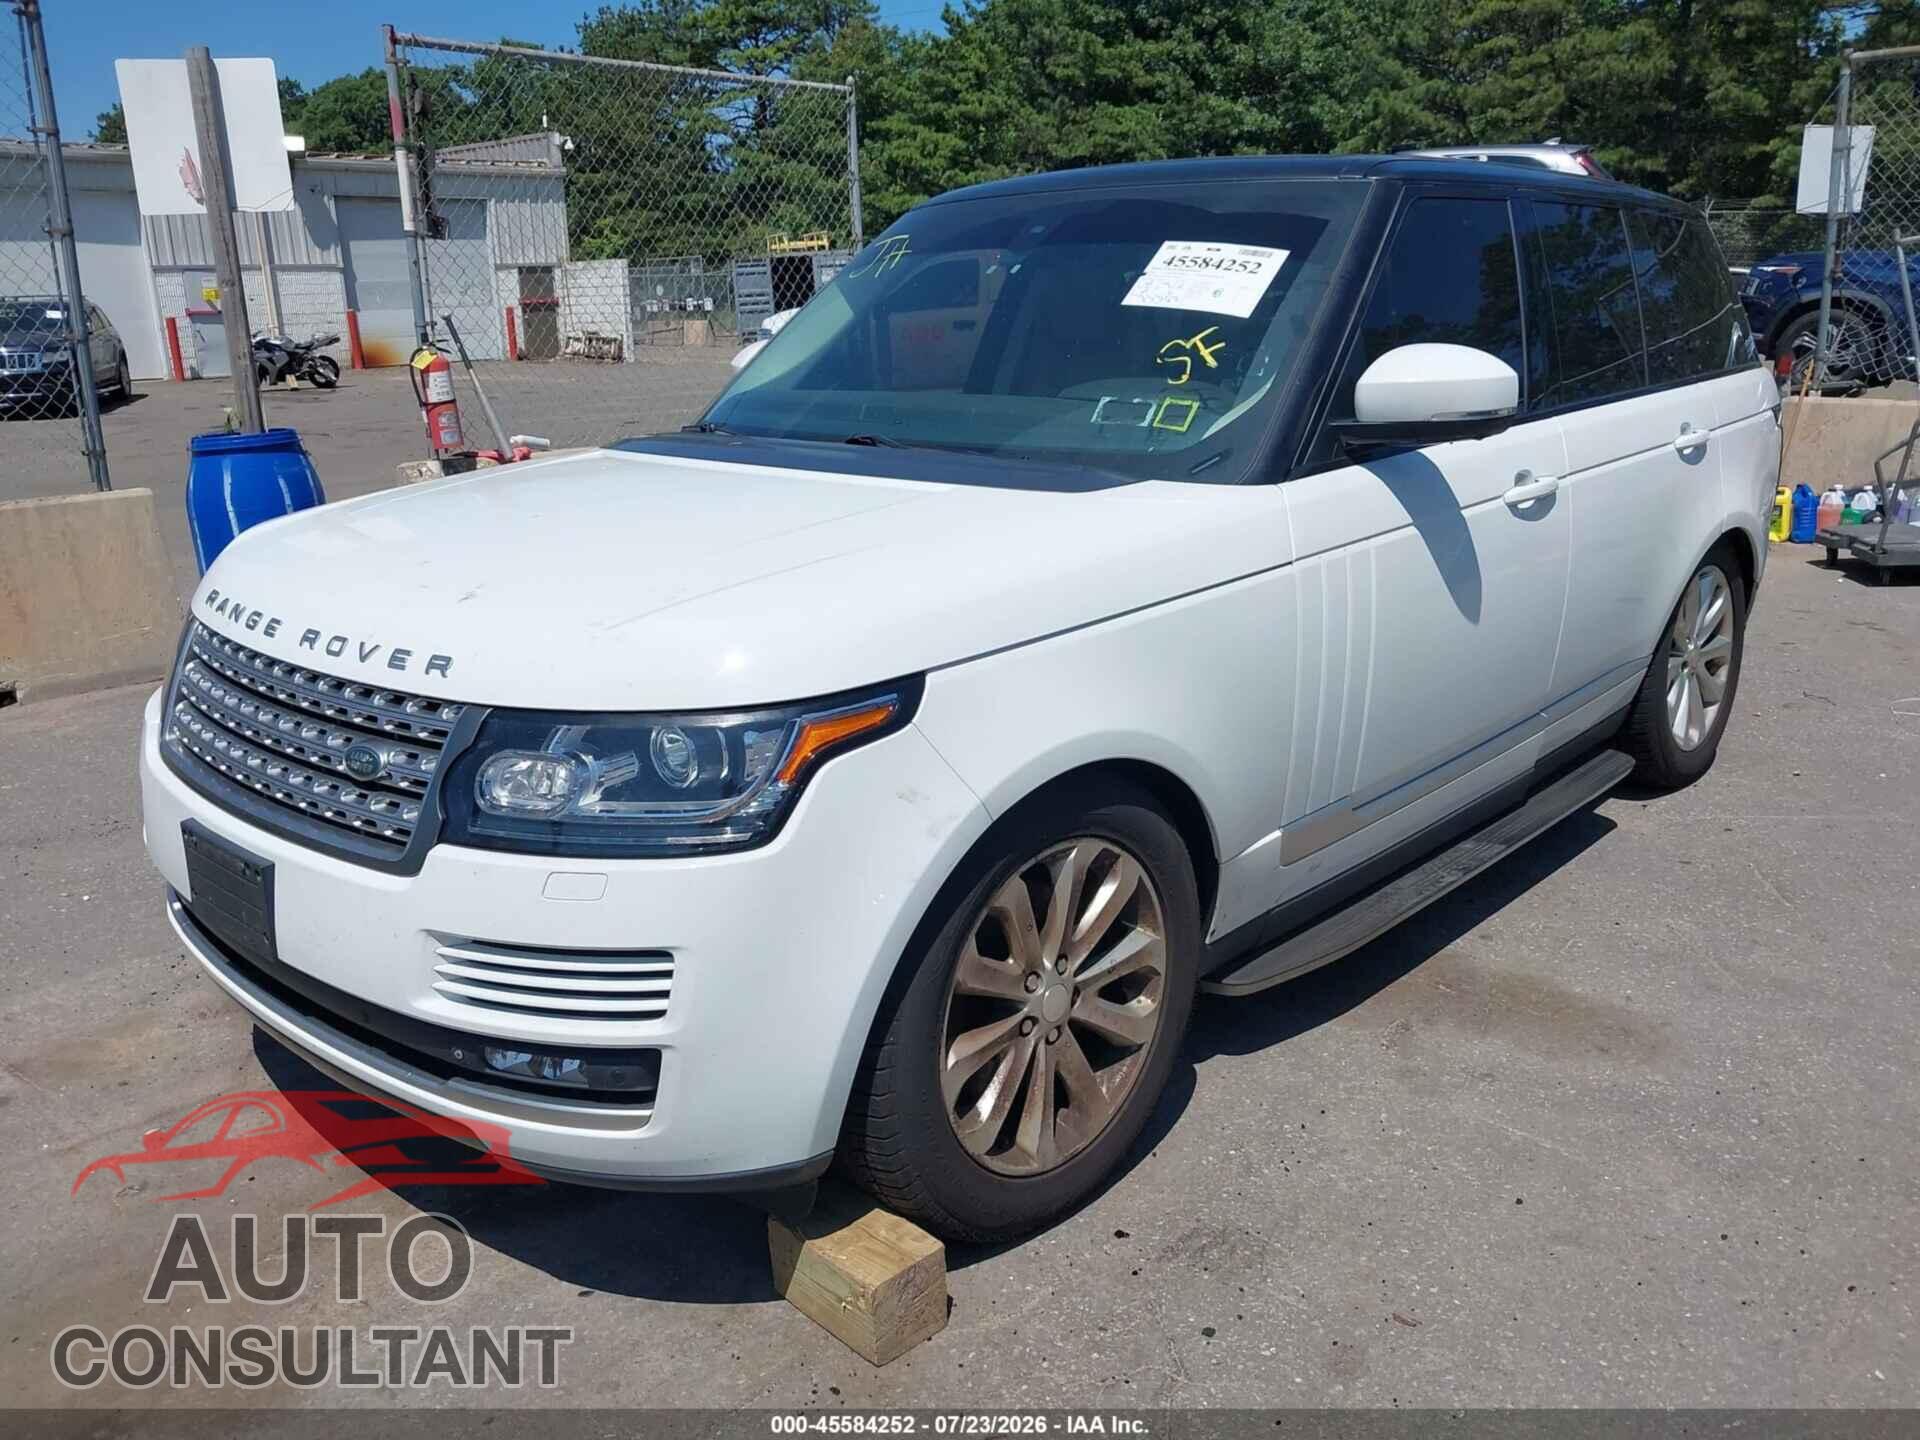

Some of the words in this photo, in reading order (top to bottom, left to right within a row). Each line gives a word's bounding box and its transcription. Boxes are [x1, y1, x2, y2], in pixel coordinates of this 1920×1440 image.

[1162, 254, 1263, 274] 45584252
[204, 588, 283, 638] RANGE
[299, 628, 454, 679] ROVER
